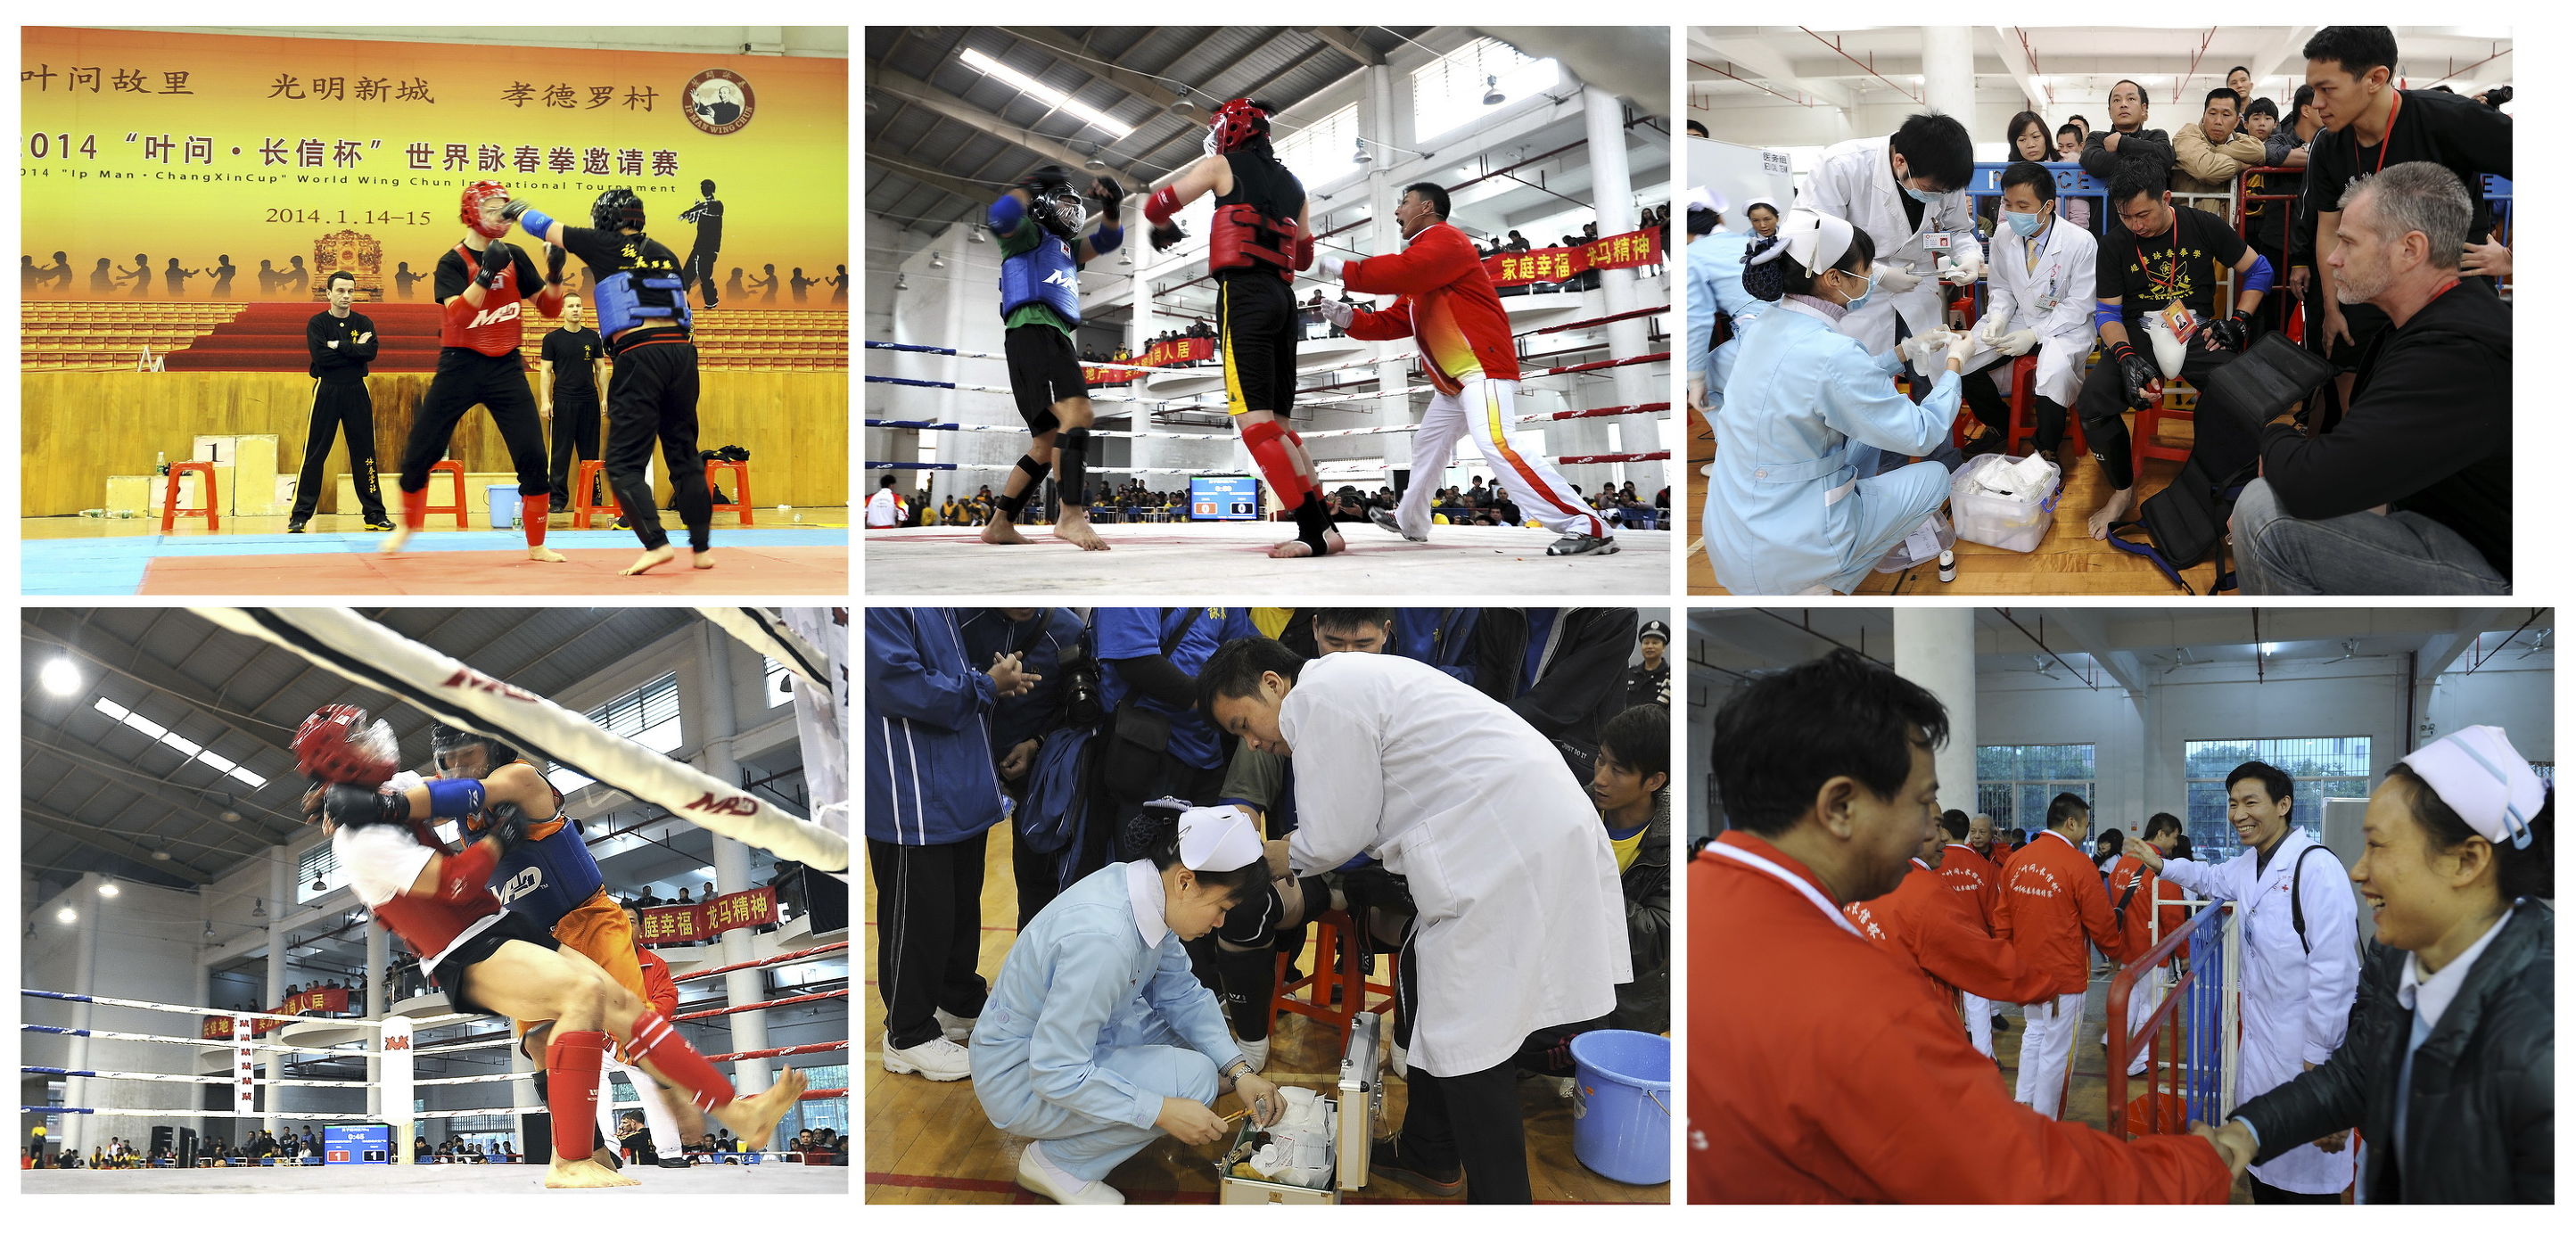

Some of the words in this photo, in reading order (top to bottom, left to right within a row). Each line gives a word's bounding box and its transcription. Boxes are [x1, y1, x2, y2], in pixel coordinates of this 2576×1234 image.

[21, 64, 193, 95] 叶问故里
[267, 73, 435, 104] 光明新城
[500, 80, 660, 112] 孝德罗村
[689, 113, 710, 131] MAN
[709, 125, 736, 134] WING
[736, 106, 753, 128] CHUN
[21, 132, 98, 160] 014
[405, 142, 679, 177] 世界詠春拳邀请赛
[1763, 152, 1788, 164] 医务组
[298, 175, 348, 184] World
[358, 176, 399, 187] Wing
[409, 177, 451, 186] Chun
[461, 179, 566, 190] Inational
[1988, 170, 2090, 190] PCE
[205, 442, 224, 462] 1
[639, 893, 768, 939] 庭幸福、龙马精神
